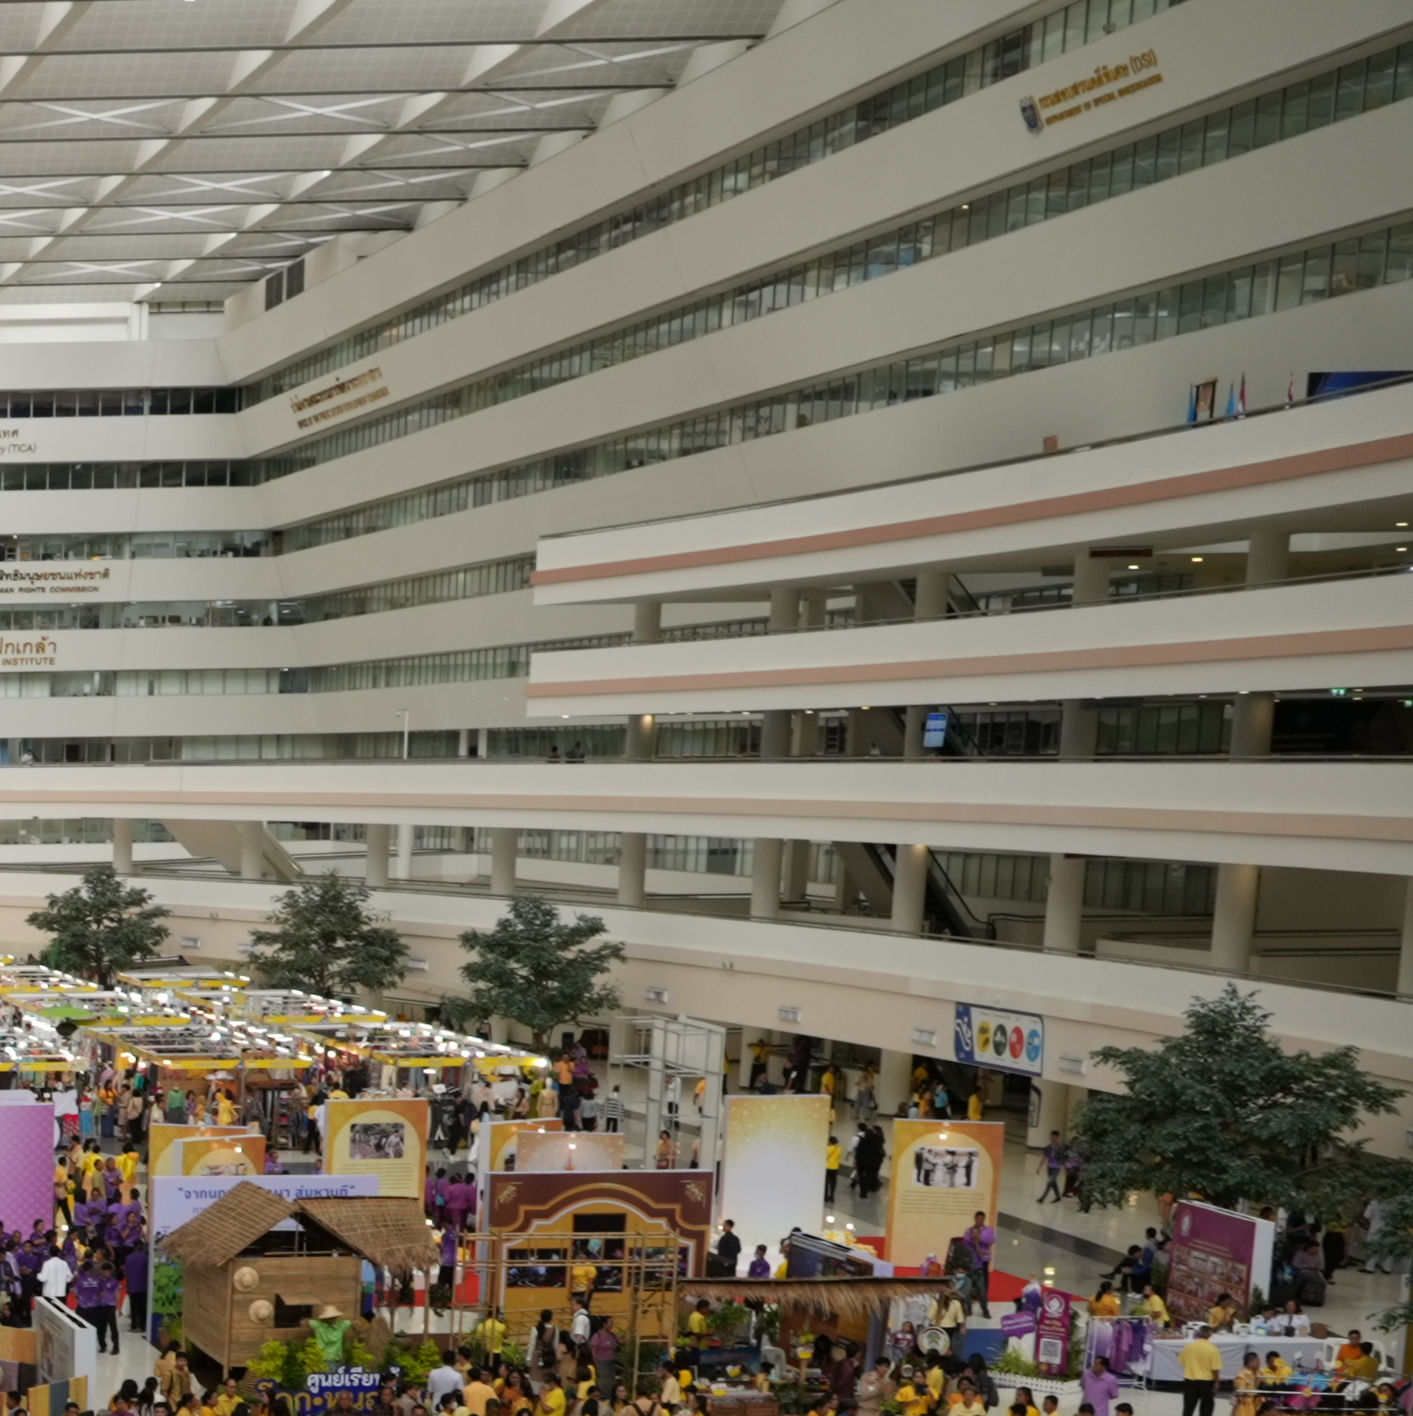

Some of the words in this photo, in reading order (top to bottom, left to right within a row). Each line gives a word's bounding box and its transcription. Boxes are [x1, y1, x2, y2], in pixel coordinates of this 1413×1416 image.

[8, 443, 38, 455] (TICA)
[18, 586, 46, 594] RIGHTS
[2, 656, 57, 667] INSTITUTE
